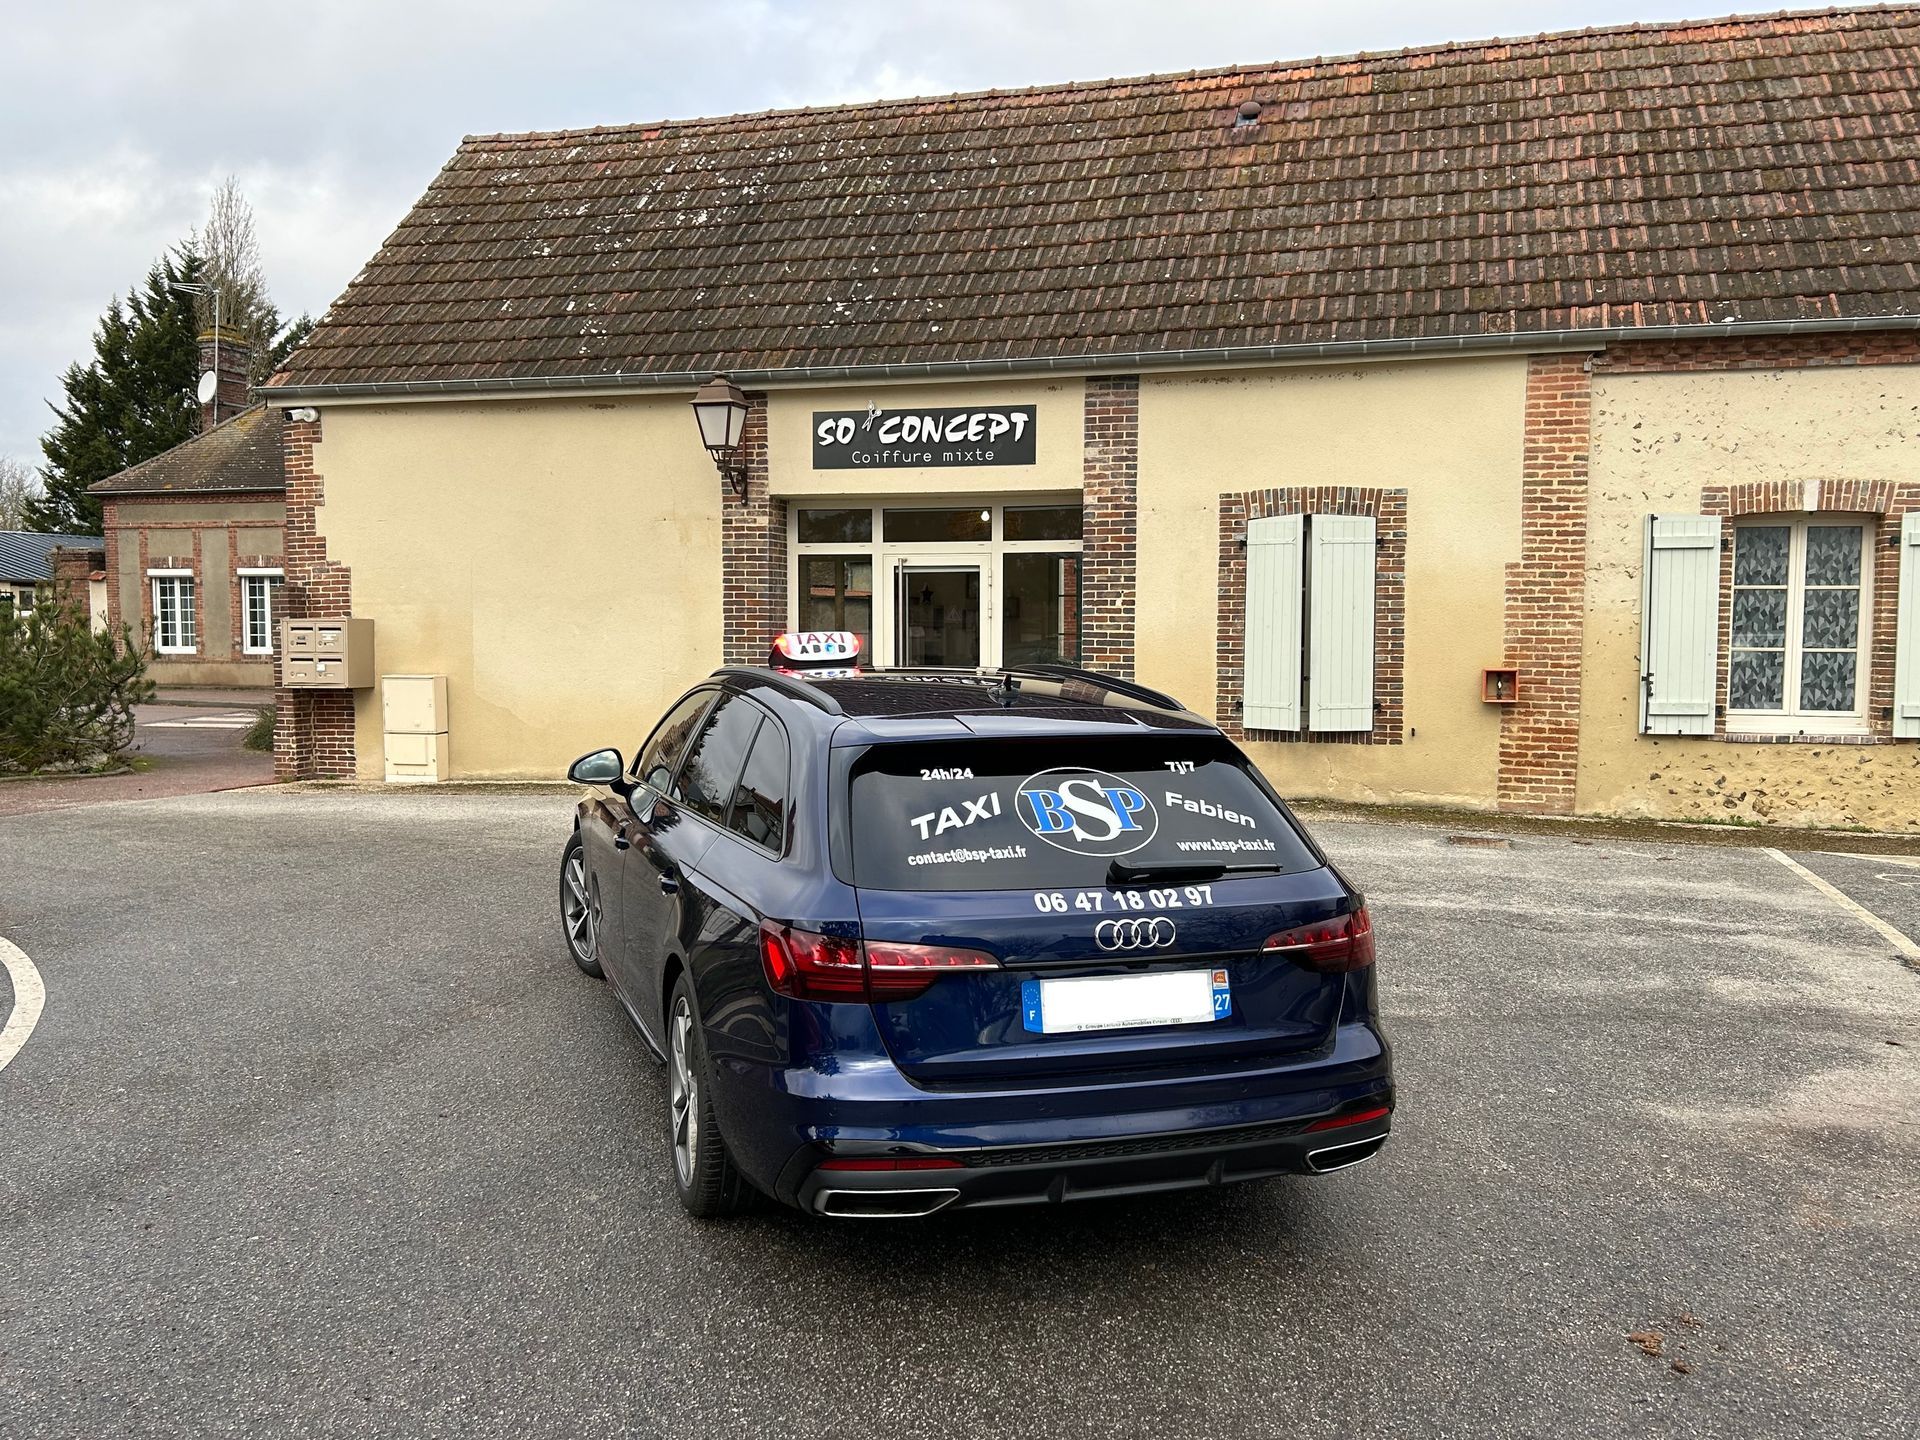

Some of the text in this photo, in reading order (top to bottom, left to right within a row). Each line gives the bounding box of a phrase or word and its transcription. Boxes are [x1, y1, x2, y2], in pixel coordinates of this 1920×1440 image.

[851, 448, 994, 464] Coiffure mixte
[792, 633, 845, 645] TAXI
[920, 767, 975, 781] 24h/24
[1164, 761, 1195, 775] 7j/7
[910, 792, 1002, 841] TAXI
[1019, 779, 1146, 842] BSP
[1165, 791, 1257, 829] Fabien
[1176, 838, 1276, 853] www.bsp-taxi.fr
[907, 845, 1027, 866] contact@bsp-taxi.fr
[1034, 885, 1214, 913] 06 47 18 02 97
[1214, 993, 1230, 1011] 27
[1029, 1010, 1036, 1021] F
